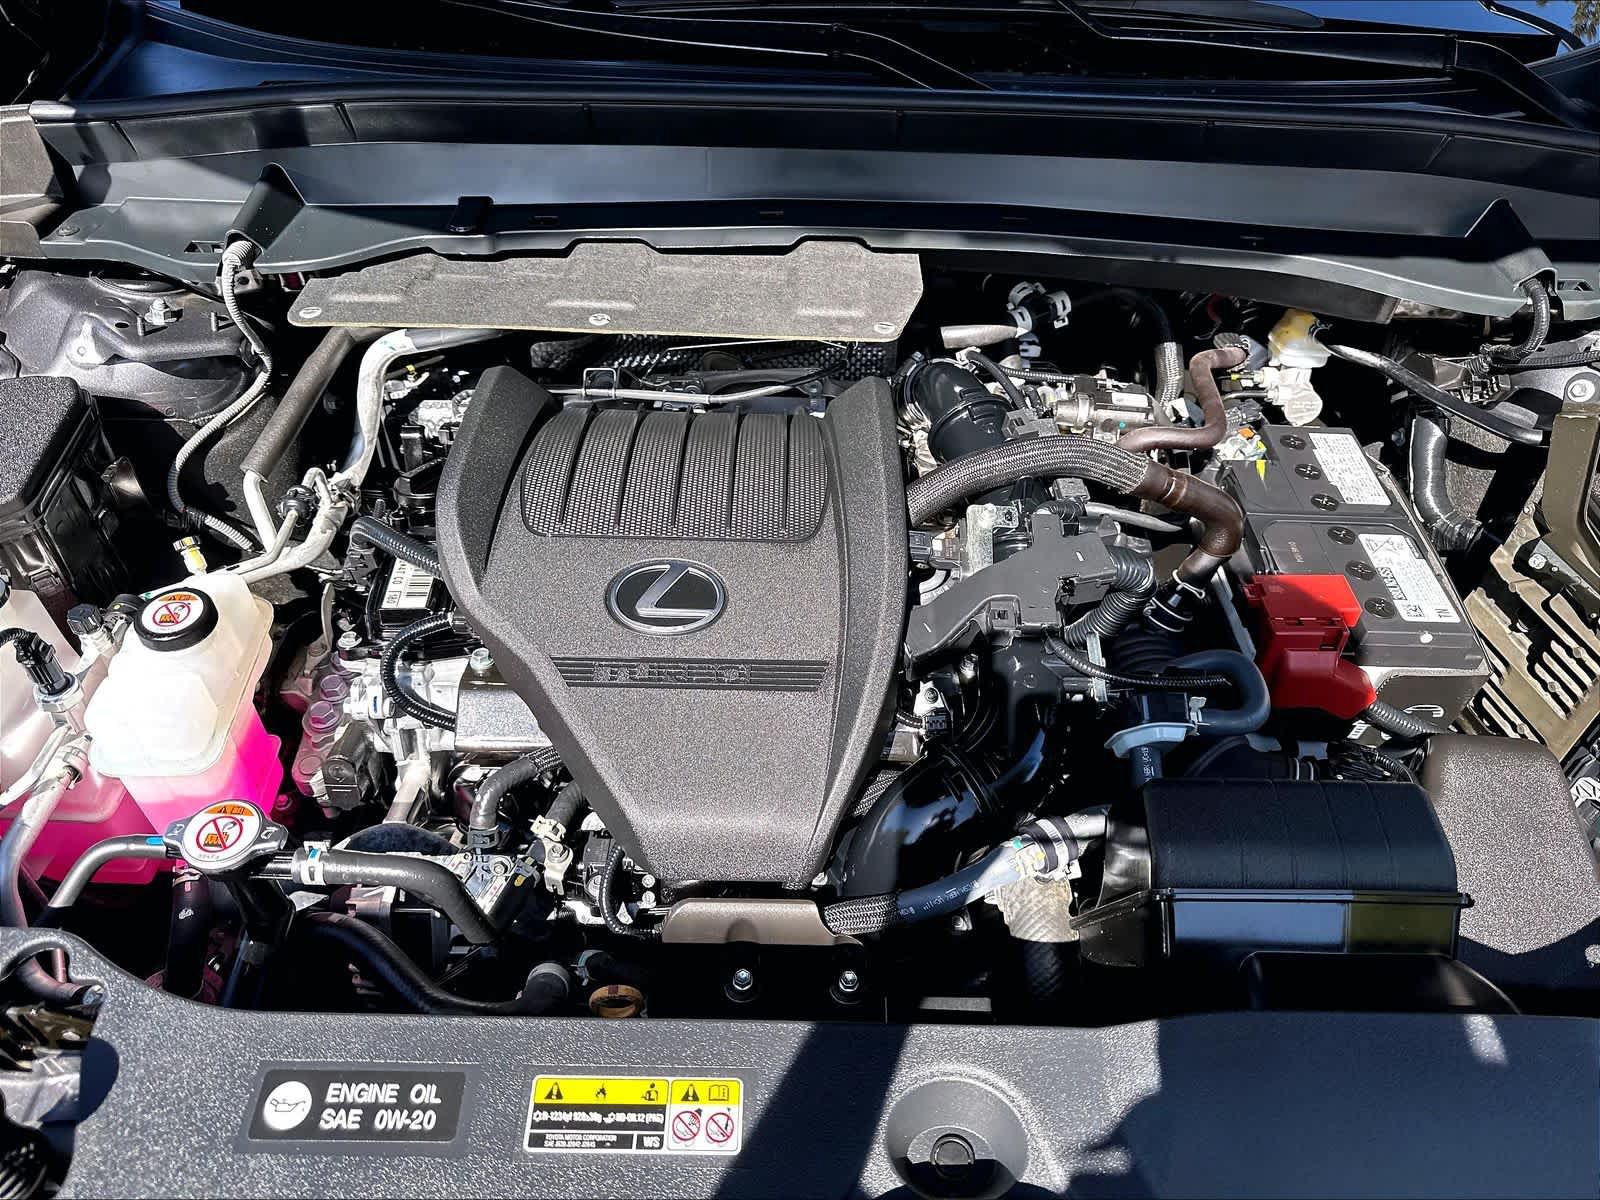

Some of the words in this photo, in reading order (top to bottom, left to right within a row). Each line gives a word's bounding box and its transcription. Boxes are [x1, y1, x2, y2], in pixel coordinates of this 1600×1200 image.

[325, 1082, 400, 1104] ENGINE
[409, 1083, 442, 1104] OIL
[318, 1108, 364, 1130] SAE
[374, 1109, 437, 1130] 0W-20
